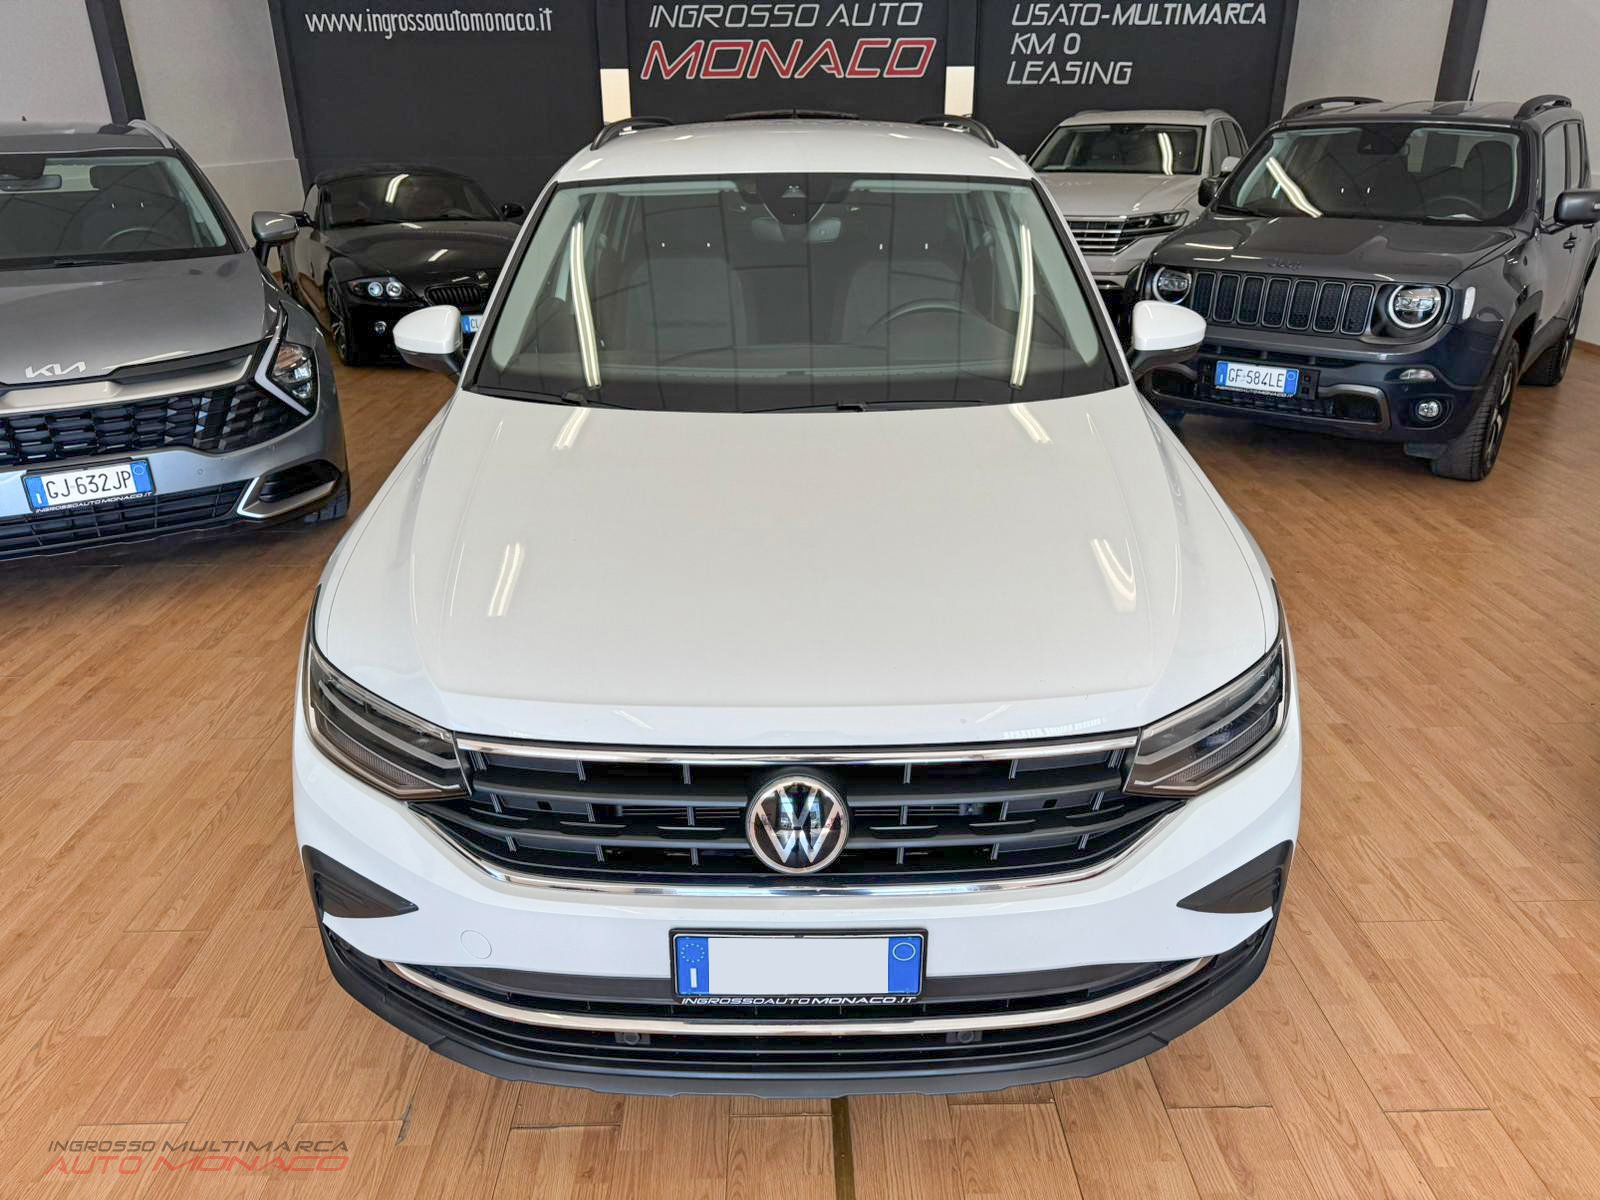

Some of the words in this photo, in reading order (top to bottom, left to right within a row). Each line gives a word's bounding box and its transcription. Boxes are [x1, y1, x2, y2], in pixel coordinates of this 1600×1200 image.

[305, 7, 553, 39] www.ingrossoautomonaco.it
[649, 4, 820, 28] INGROSSO
[826, 2, 923, 27] AUTO
[1010, 32, 1056, 55] KM
[640, 37, 937, 80] MONACO
[1006, 61, 1133, 85] LEASING
